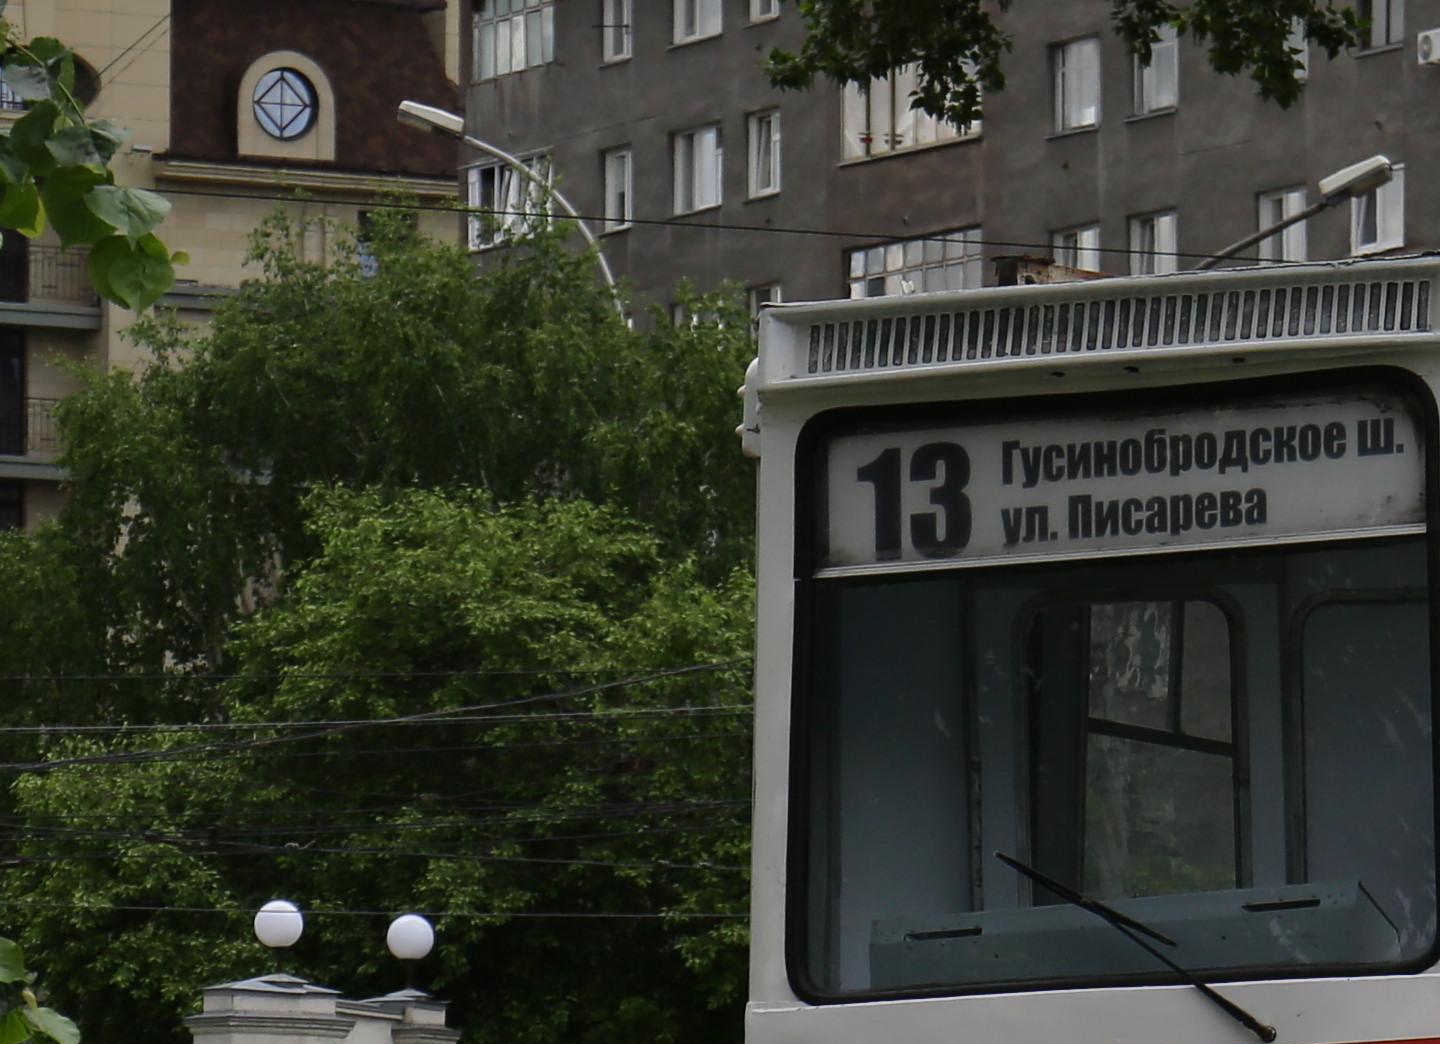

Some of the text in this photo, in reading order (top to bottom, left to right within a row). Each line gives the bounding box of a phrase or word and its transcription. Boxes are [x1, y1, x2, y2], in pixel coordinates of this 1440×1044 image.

[1002, 418, 1404, 489] Гусинобродское ш.
[856, 441, 972, 561] 13
[1001, 488, 1267, 546] ул. Писарева
